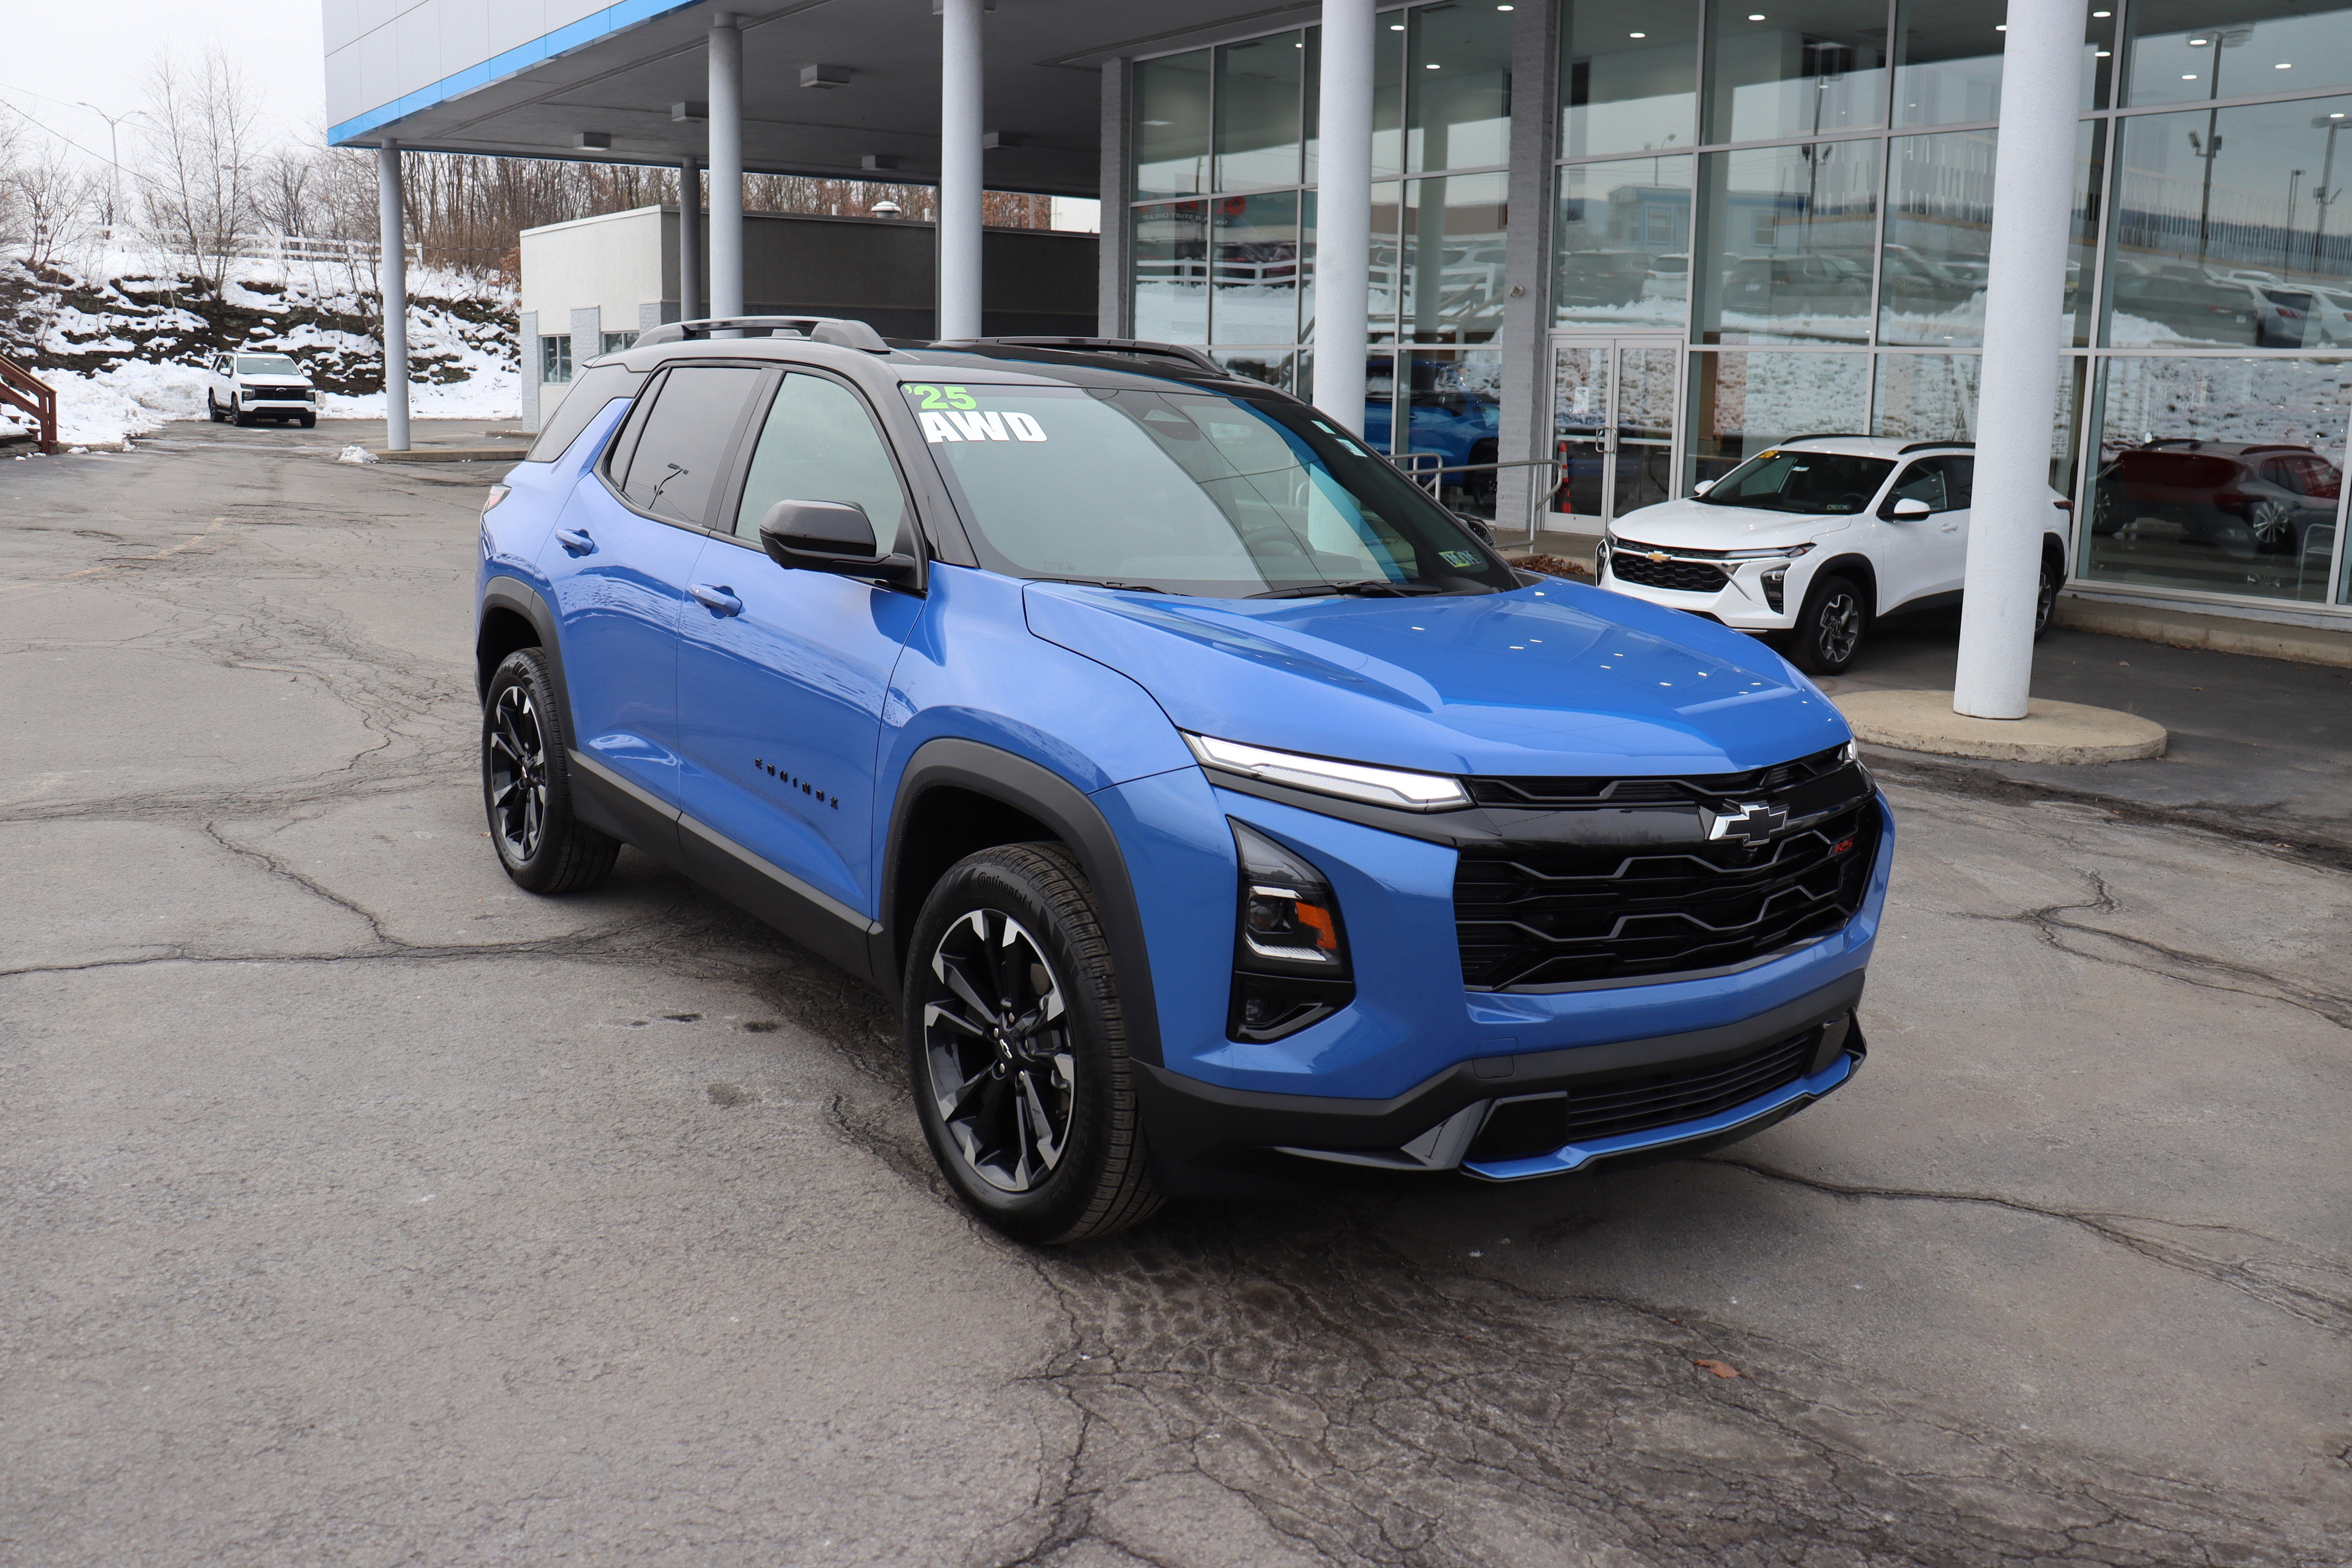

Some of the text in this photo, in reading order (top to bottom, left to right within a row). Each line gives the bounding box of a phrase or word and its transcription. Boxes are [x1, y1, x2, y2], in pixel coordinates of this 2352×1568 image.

[904, 385, 977, 410] '25
[918, 410, 1047, 443] AWD
[755, 757, 838, 810] EQUINOX
[977, 872, 1027, 906] Continental
